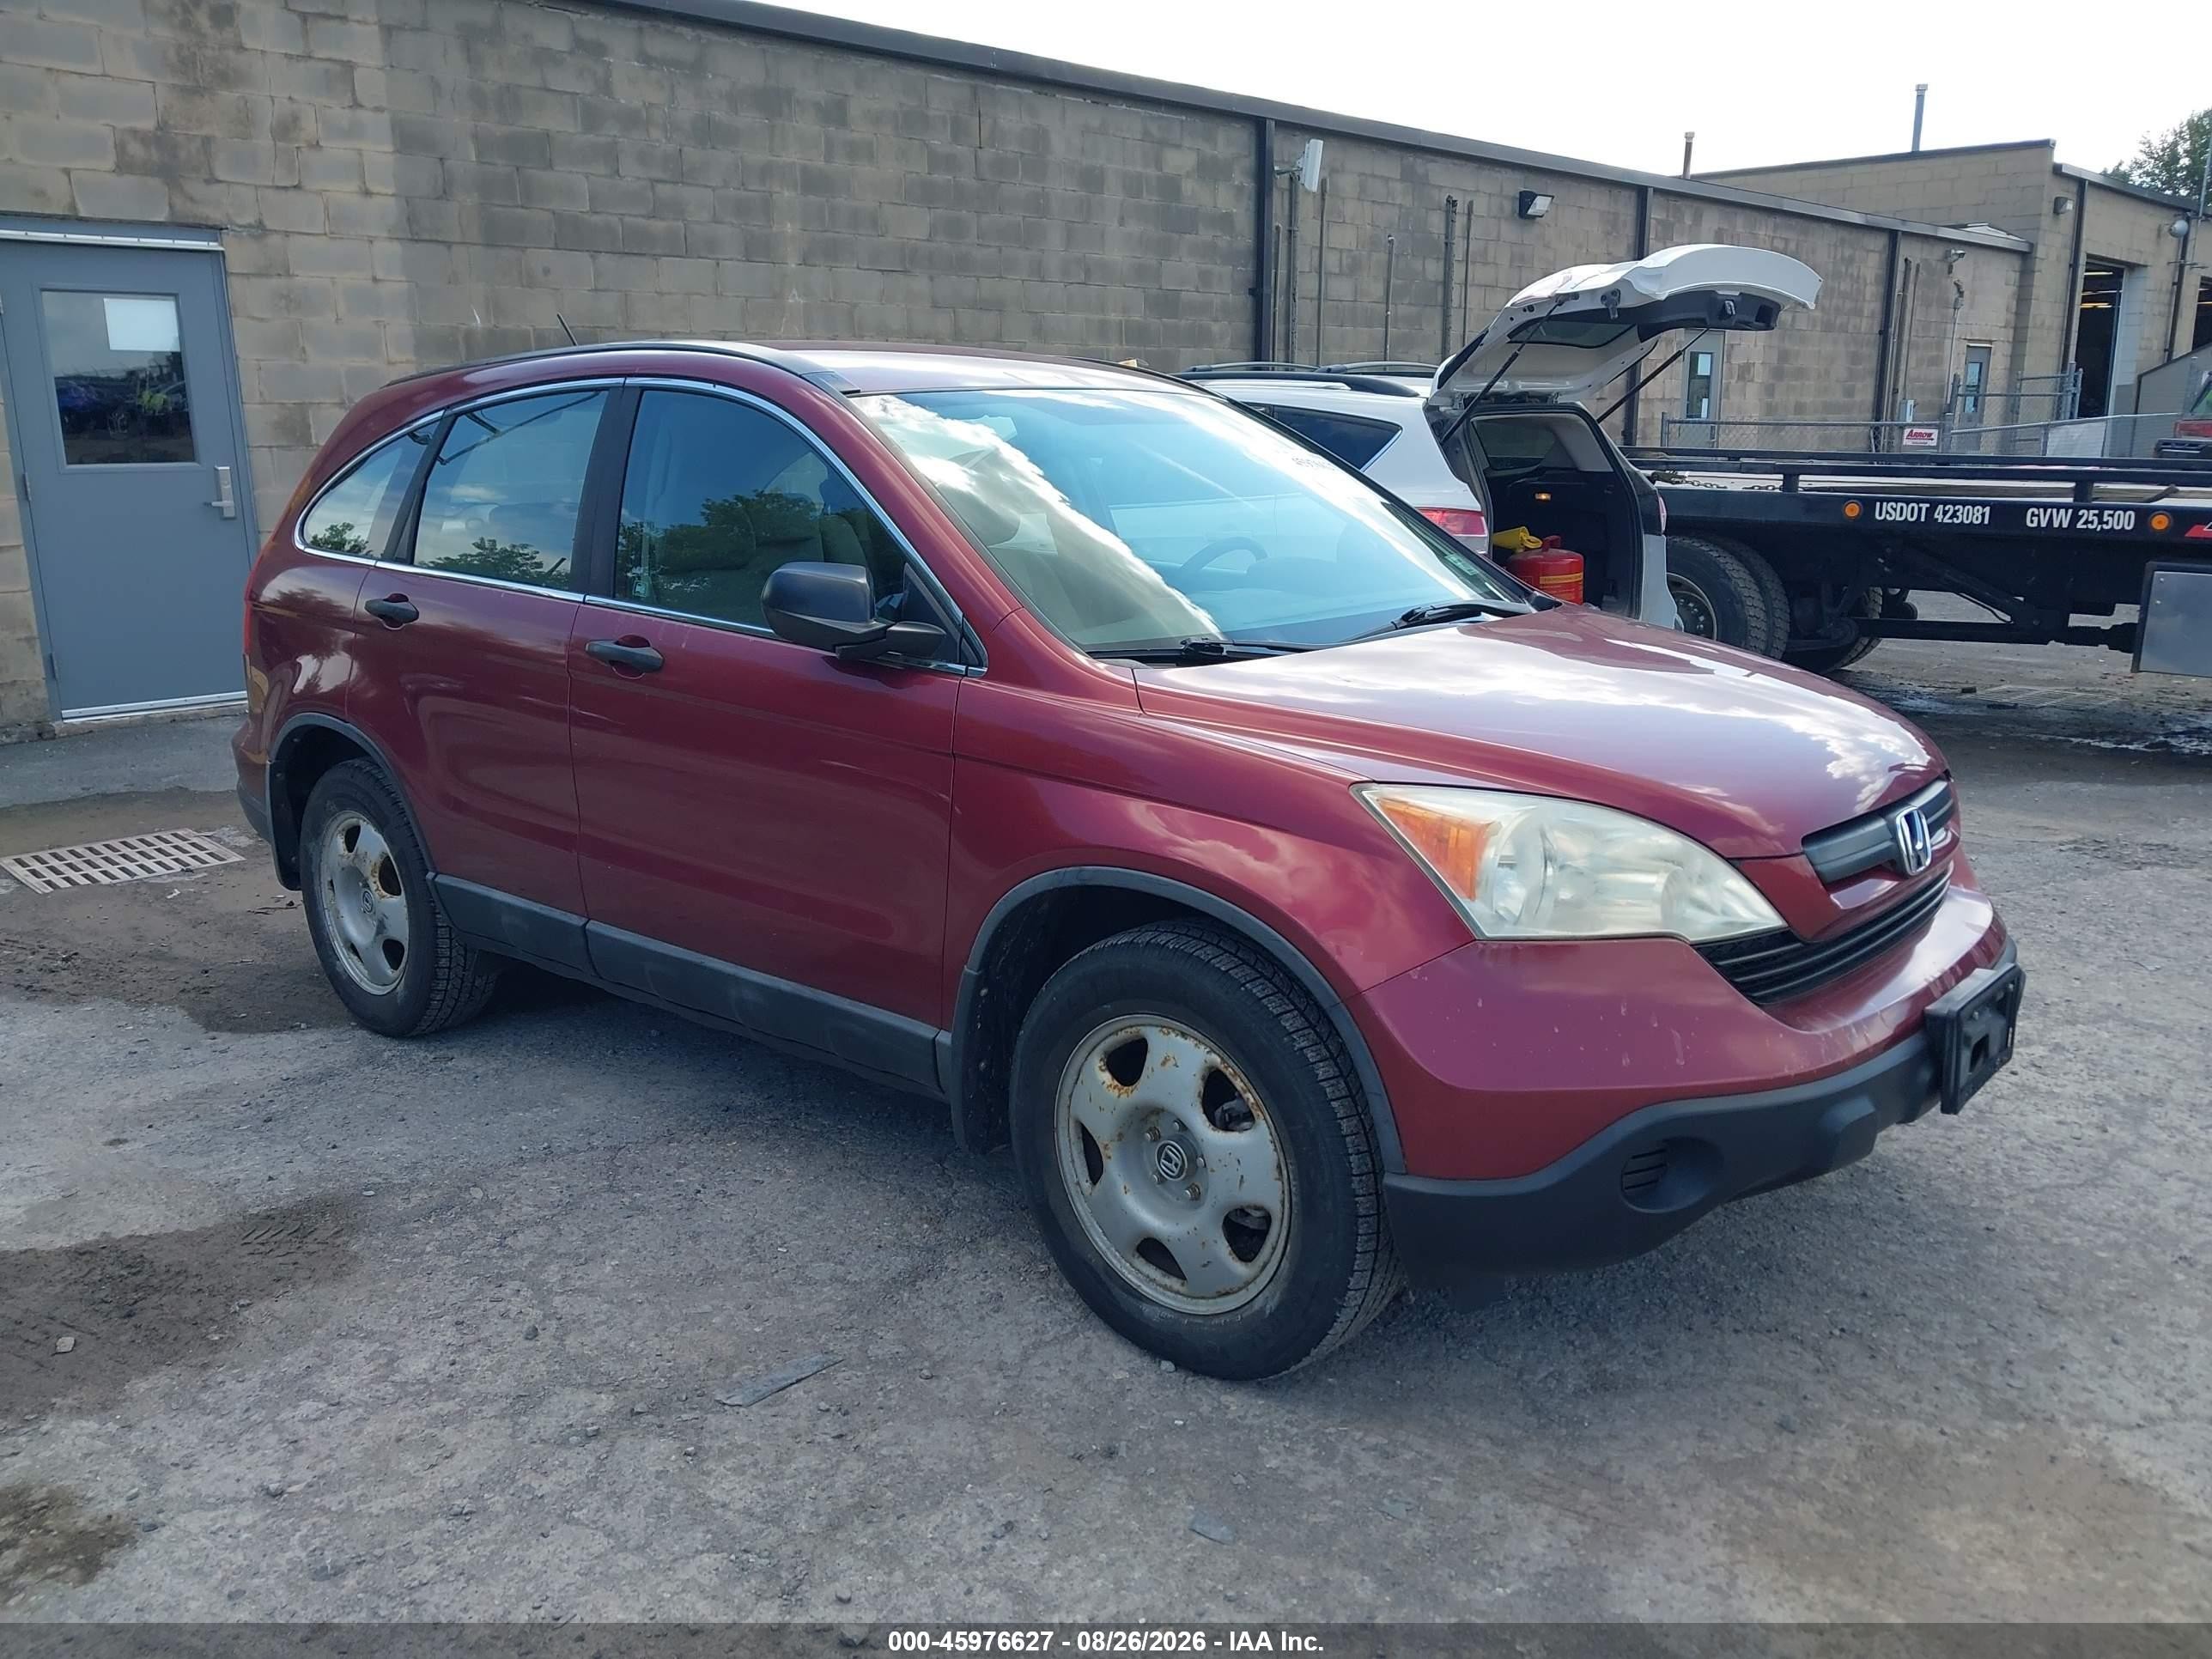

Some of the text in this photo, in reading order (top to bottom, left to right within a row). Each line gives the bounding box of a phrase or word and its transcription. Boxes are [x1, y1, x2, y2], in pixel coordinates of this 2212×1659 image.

[1875, 501, 1990, 525] USDOT 423081
[2026, 507, 2136, 532] GVW 25,500
